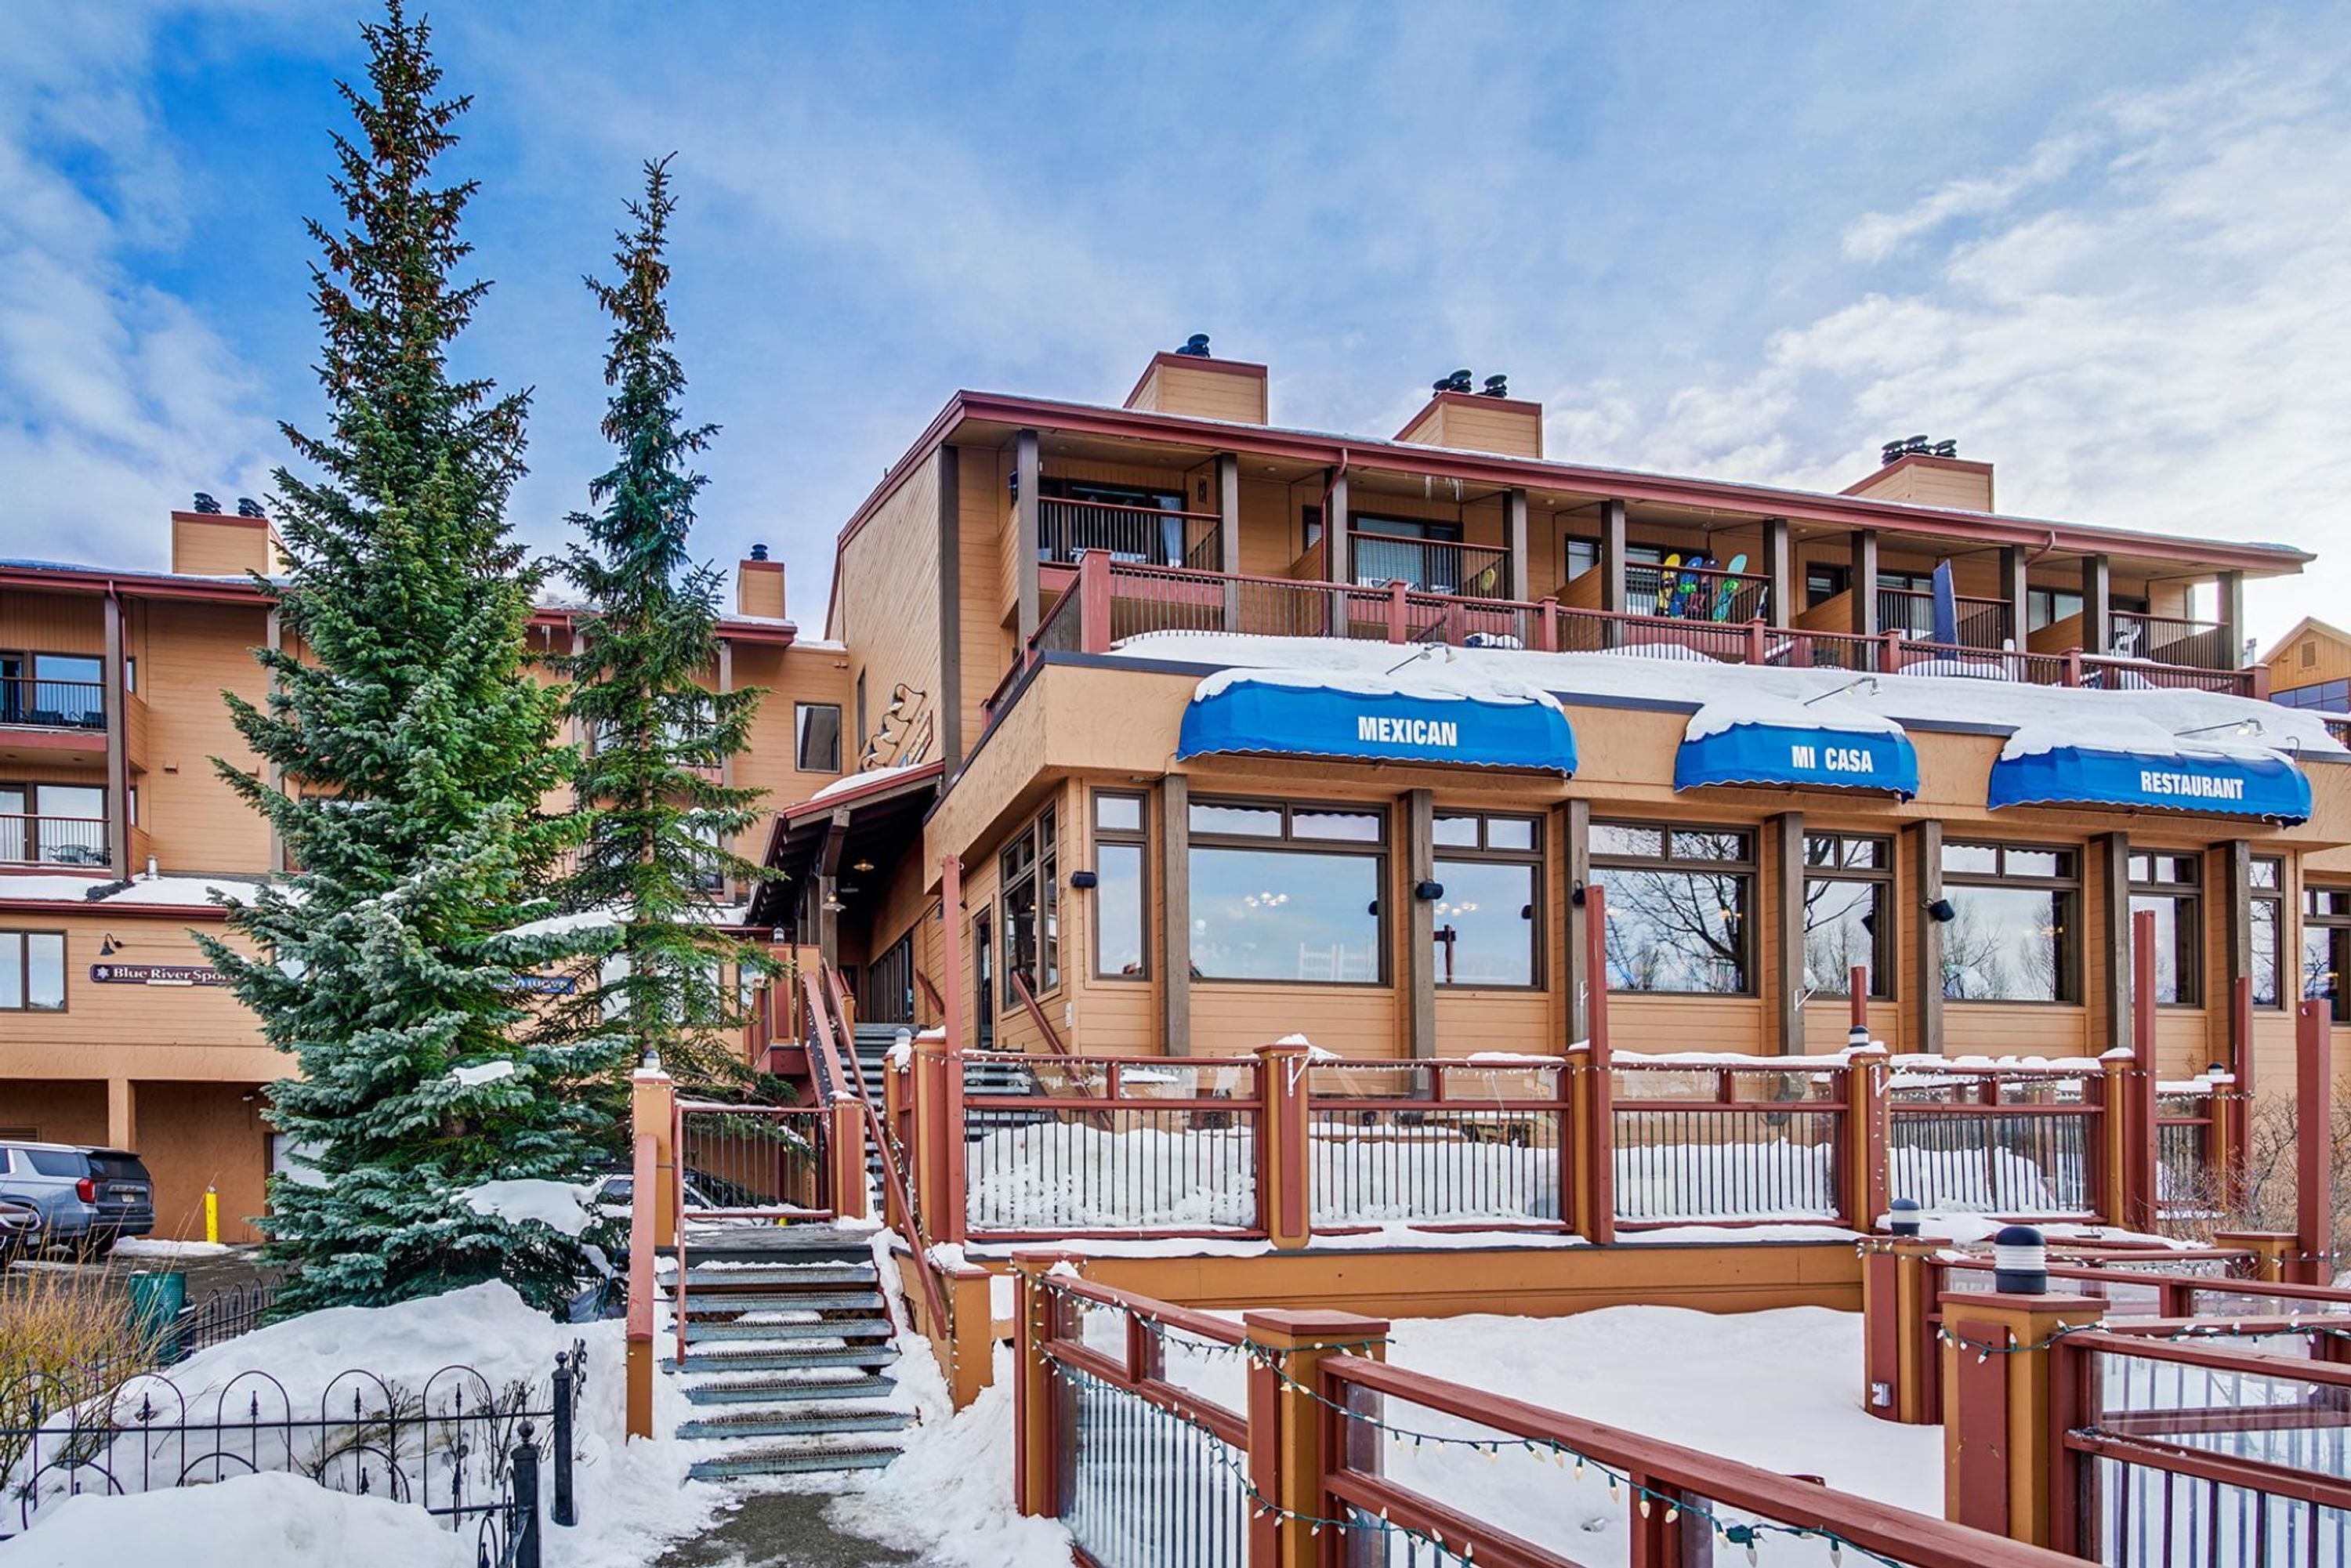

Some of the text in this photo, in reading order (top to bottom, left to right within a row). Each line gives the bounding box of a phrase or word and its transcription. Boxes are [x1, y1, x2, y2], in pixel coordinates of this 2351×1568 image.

[1358, 716, 1458, 747] MEXICAN
[1791, 745, 1874, 773] MI CASA
[2140, 771, 2244, 799] RESTAURANT
[113, 967, 147, 979] Blue
[150, 969, 191, 980] River
